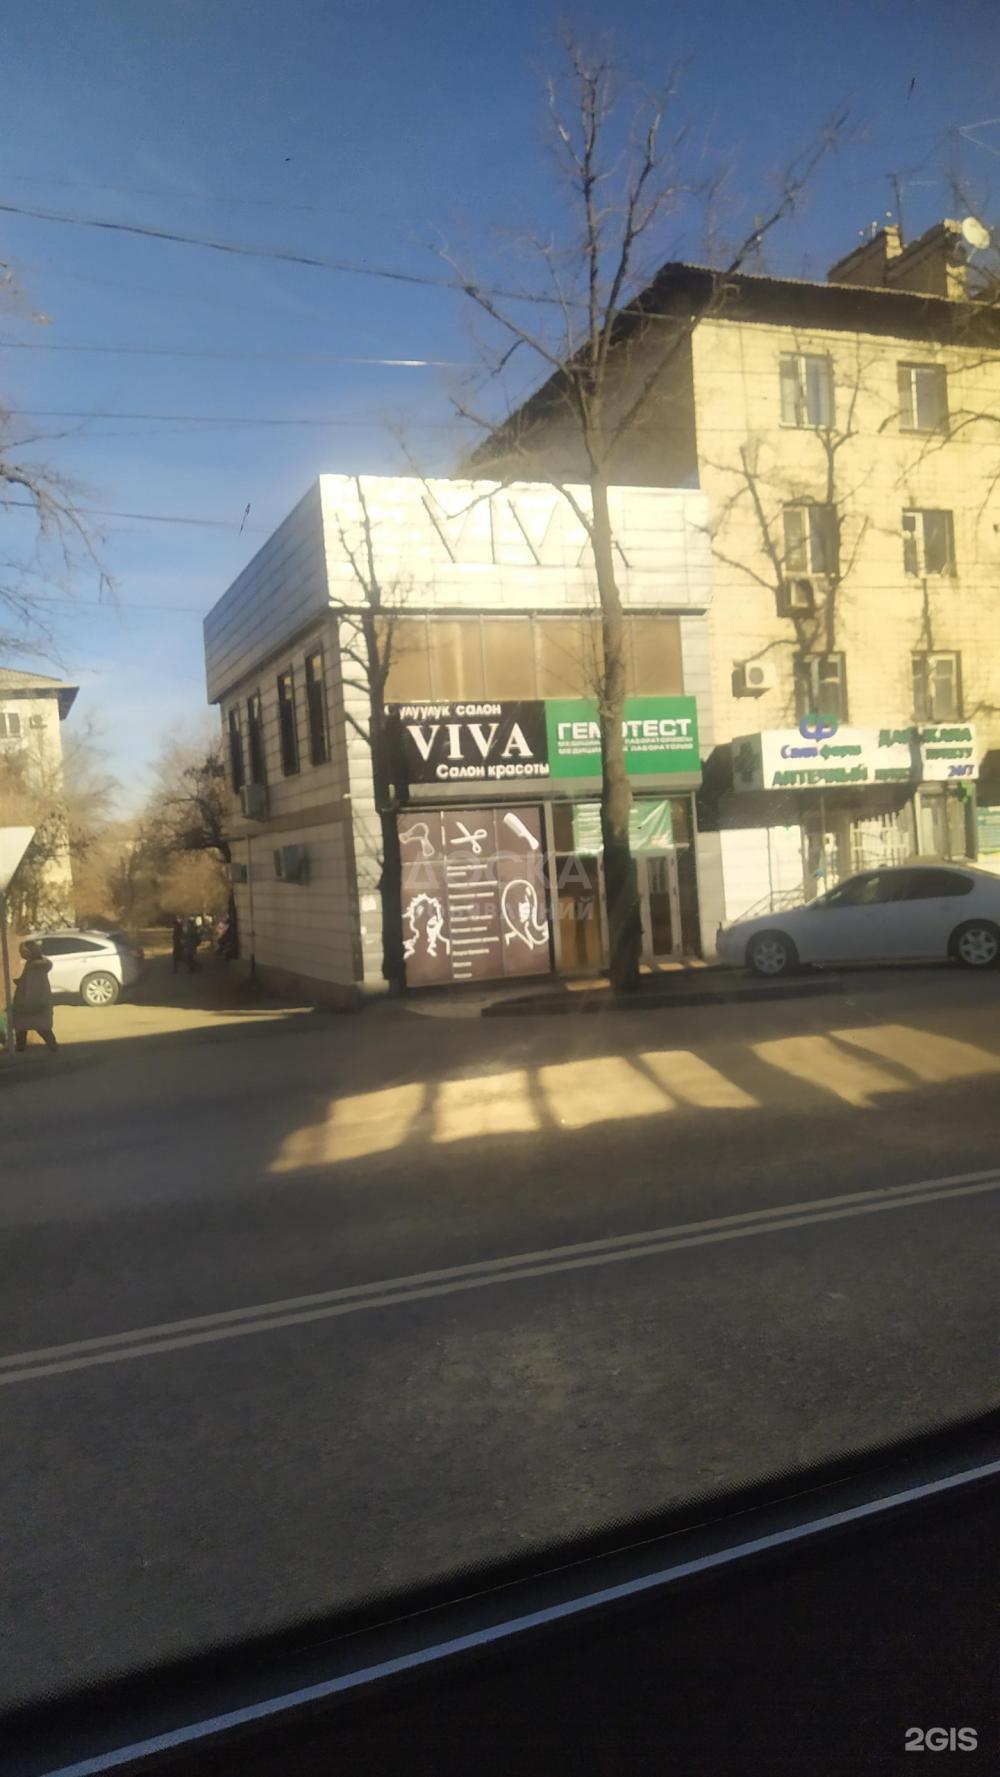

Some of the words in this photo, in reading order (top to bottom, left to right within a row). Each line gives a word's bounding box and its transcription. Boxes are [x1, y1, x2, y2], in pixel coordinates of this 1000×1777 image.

[455, 703, 502, 717] салон
[558, 718, 692, 740] ГЕМТЕСТ
[406, 722, 534, 761] VIVA
[436, 764, 486, 779] Салон
[487, 762, 550, 780] красоты
